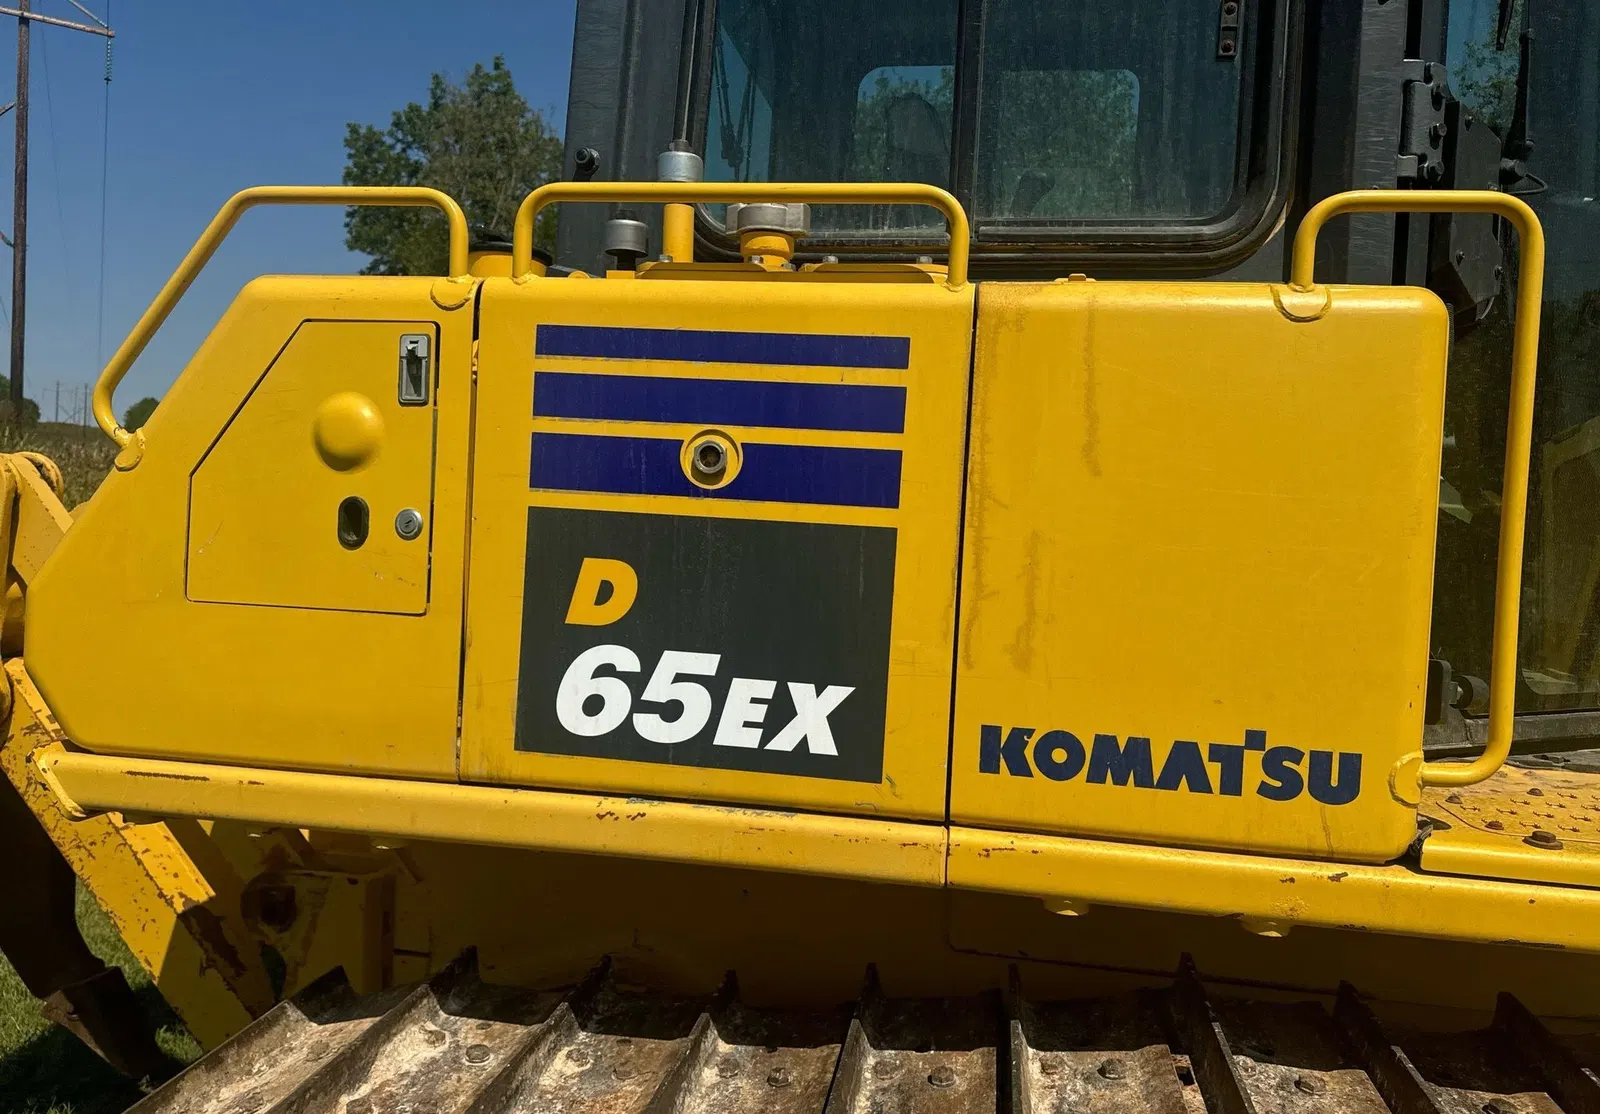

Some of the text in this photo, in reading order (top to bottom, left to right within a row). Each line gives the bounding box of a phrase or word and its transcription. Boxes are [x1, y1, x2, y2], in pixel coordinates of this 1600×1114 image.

[565, 557, 638, 627] D
[556, 644, 855, 756] 65EX
[979, 725, 1362, 806] KOMATSU
